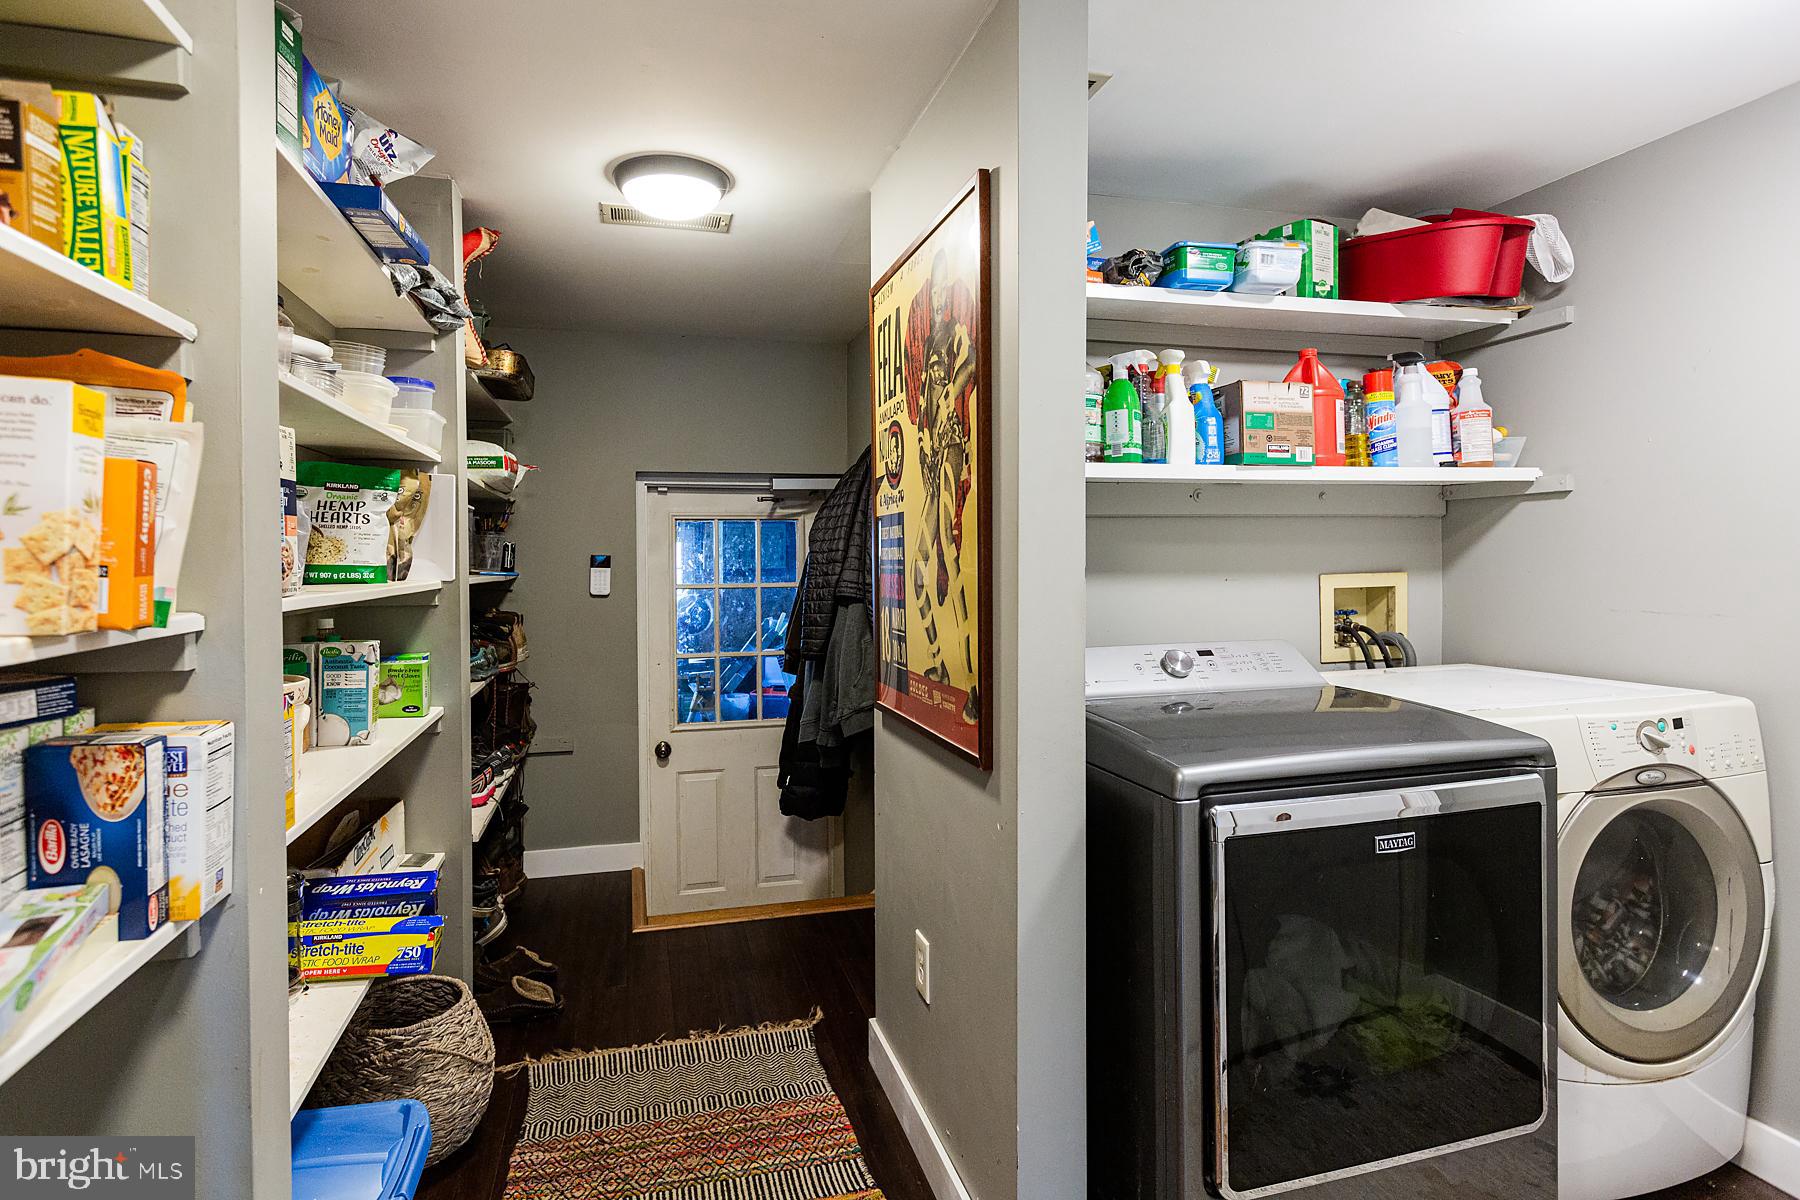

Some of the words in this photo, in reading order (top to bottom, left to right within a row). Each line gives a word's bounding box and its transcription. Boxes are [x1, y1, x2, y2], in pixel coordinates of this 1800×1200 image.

[315, 101, 340, 137] Honey
[319, 121, 338, 149] Maid
[60, 128, 98, 208] NATURE
[73, 208, 101, 274] VALLE
[877, 306, 903, 408] FELA
[1300, 386, 1309, 396] 72
[326, 482, 359, 490] KIRKLAND
[326, 491, 358, 502] Organic
[141, 467, 153, 545] Crunchy
[316, 500, 367, 512] HEMP
[310, 511, 371, 525] HEARTS
[45, 823, 58, 861] Barilla
[80, 823, 91, 868] LASAGNE
[1379, 837, 1414, 850] MAYTAG
[311, 883, 353, 896] Wrap
[355, 877, 428, 893] Reynolds
[308, 907, 352, 921] Wrap
[353, 901, 426, 918] Reynolds
[397, 946, 421, 958] 750
[322, 957, 350, 967] FOOD
[352, 955, 380, 964] WRAP
